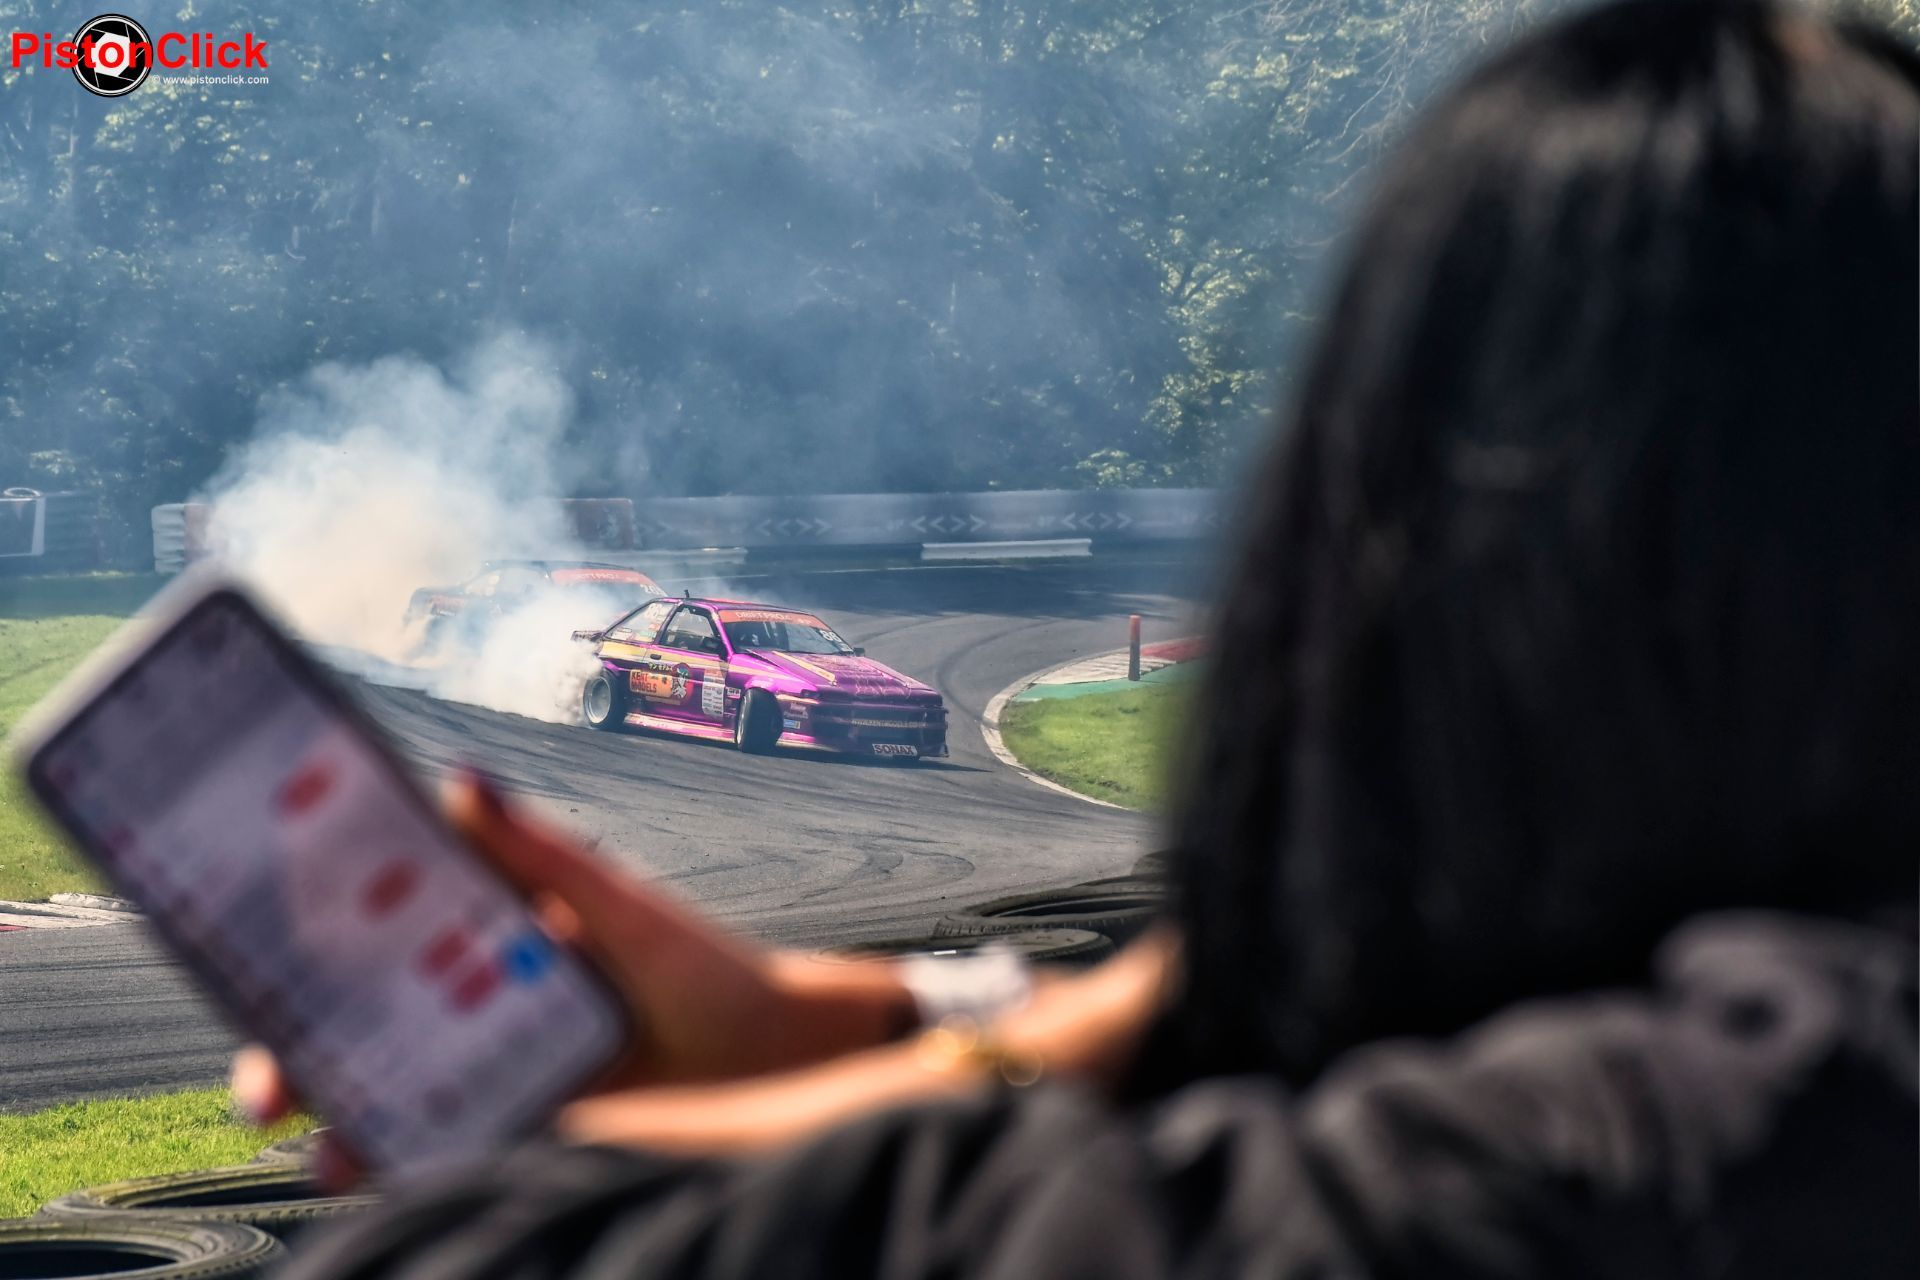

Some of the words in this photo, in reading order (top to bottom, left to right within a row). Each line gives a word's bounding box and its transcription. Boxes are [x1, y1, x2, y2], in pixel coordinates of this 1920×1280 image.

[819, 629, 842, 643] 88
[631, 671, 649, 682] KENT
[631, 680, 658, 693] MODELS
[874, 744, 914, 755] SONAX
